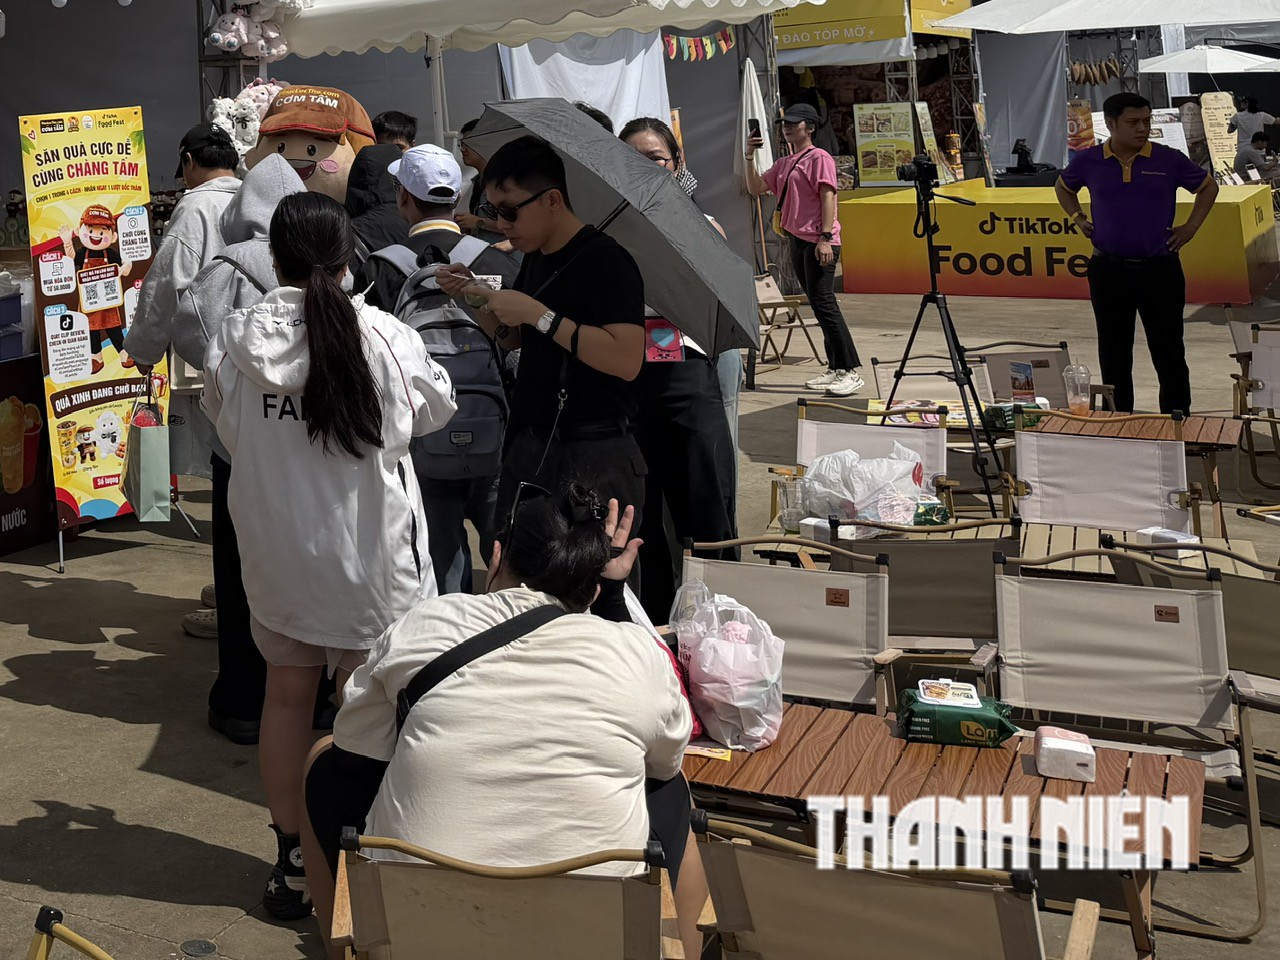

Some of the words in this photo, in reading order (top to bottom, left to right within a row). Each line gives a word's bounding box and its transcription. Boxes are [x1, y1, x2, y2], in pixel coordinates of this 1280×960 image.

[275, 94, 306, 107] CƠM
[309, 94, 339, 109] TẤM
[35, 149, 60, 167] SĂN
[64, 141, 87, 161] QUÀ
[91, 142, 114, 159] CỰC
[32, 167, 64, 188] CÙNG
[67, 161, 109, 179] CHÀNG
[112, 157, 139, 177] TẤM
[1004, 216, 1079, 236] TikTok
[933, 244, 1032, 277] Food
[1045, 246, 1089, 279] Fe
[55, 394, 71, 413] QUÀ
[71, 390, 91, 406] XINH
[91, 386, 114, 400] ĐANG
[1, 507, 27, 532] NƯỚC
